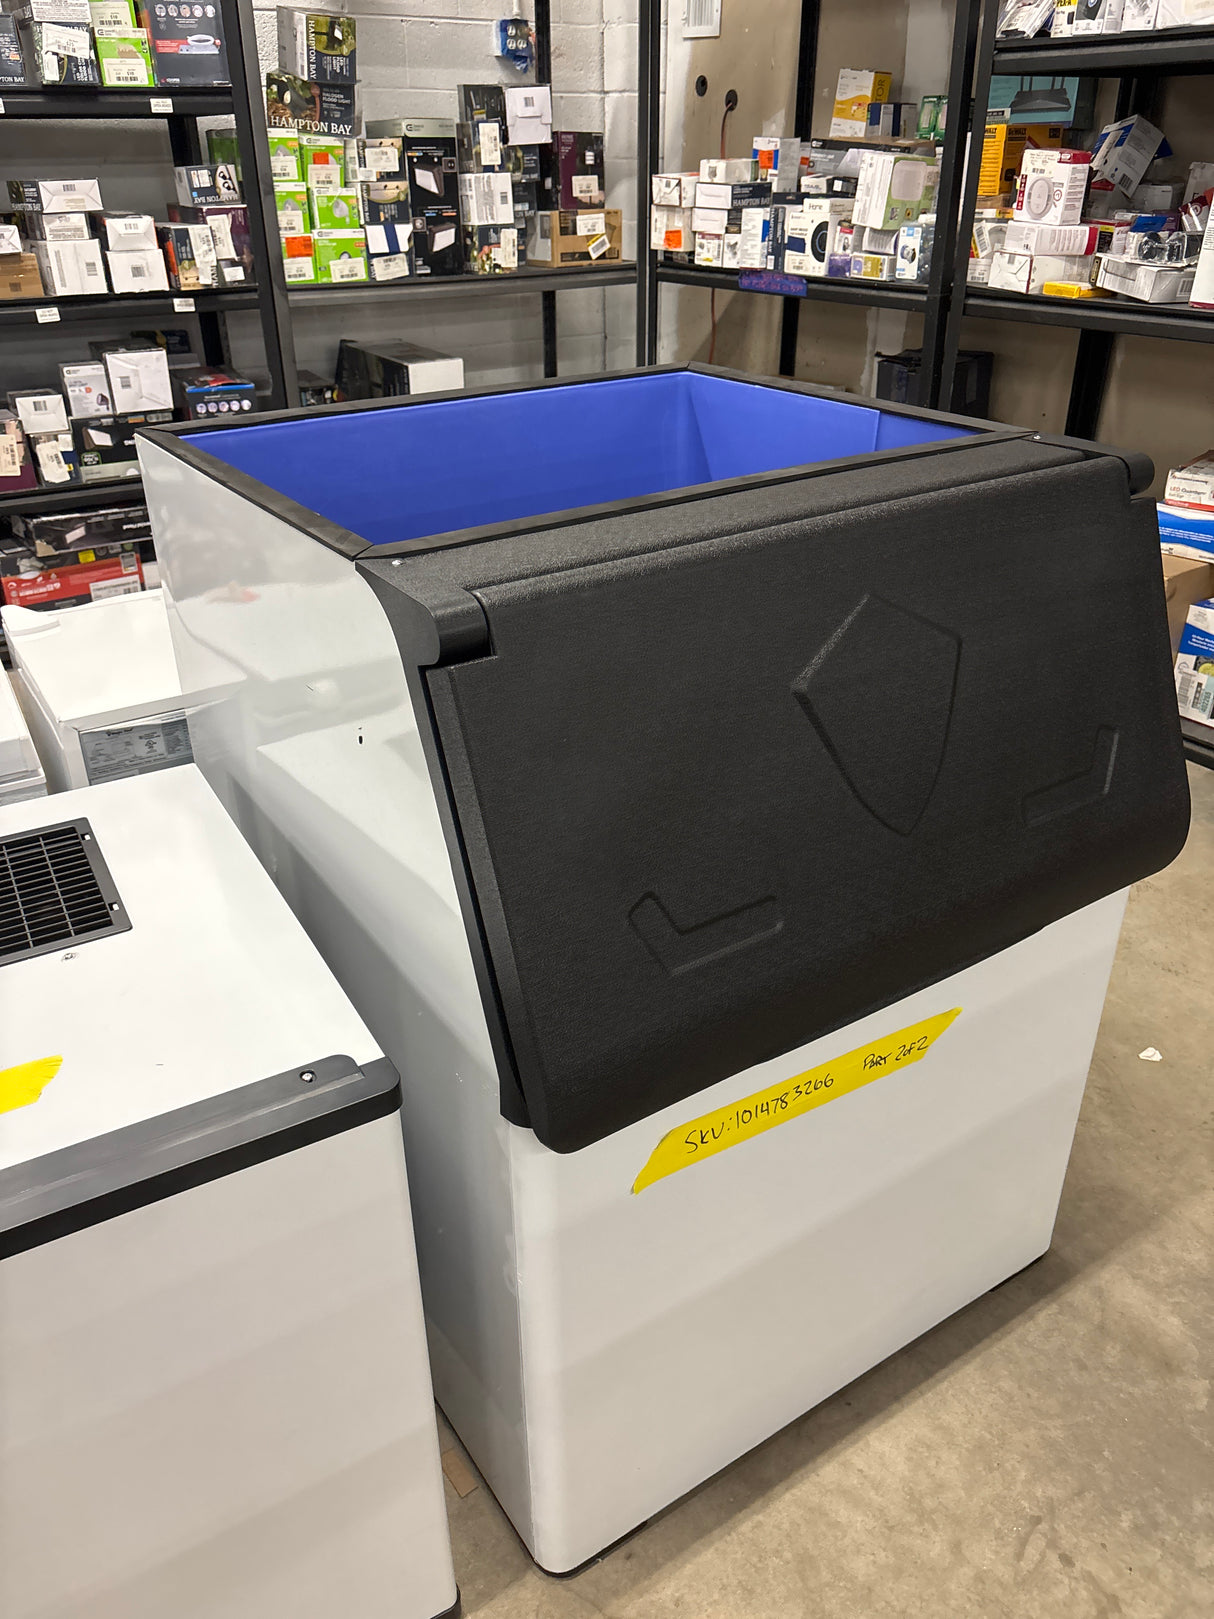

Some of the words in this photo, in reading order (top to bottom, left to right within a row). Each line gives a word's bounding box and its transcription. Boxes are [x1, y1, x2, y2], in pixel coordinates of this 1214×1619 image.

[308, 20, 317, 62] HAMPTON
[309, 64, 317, 80] BAY
[270, 115, 329, 133] HAMPTON
[330, 123, 353, 136] BAY
[732, 198, 760, 207] HAMPTON
